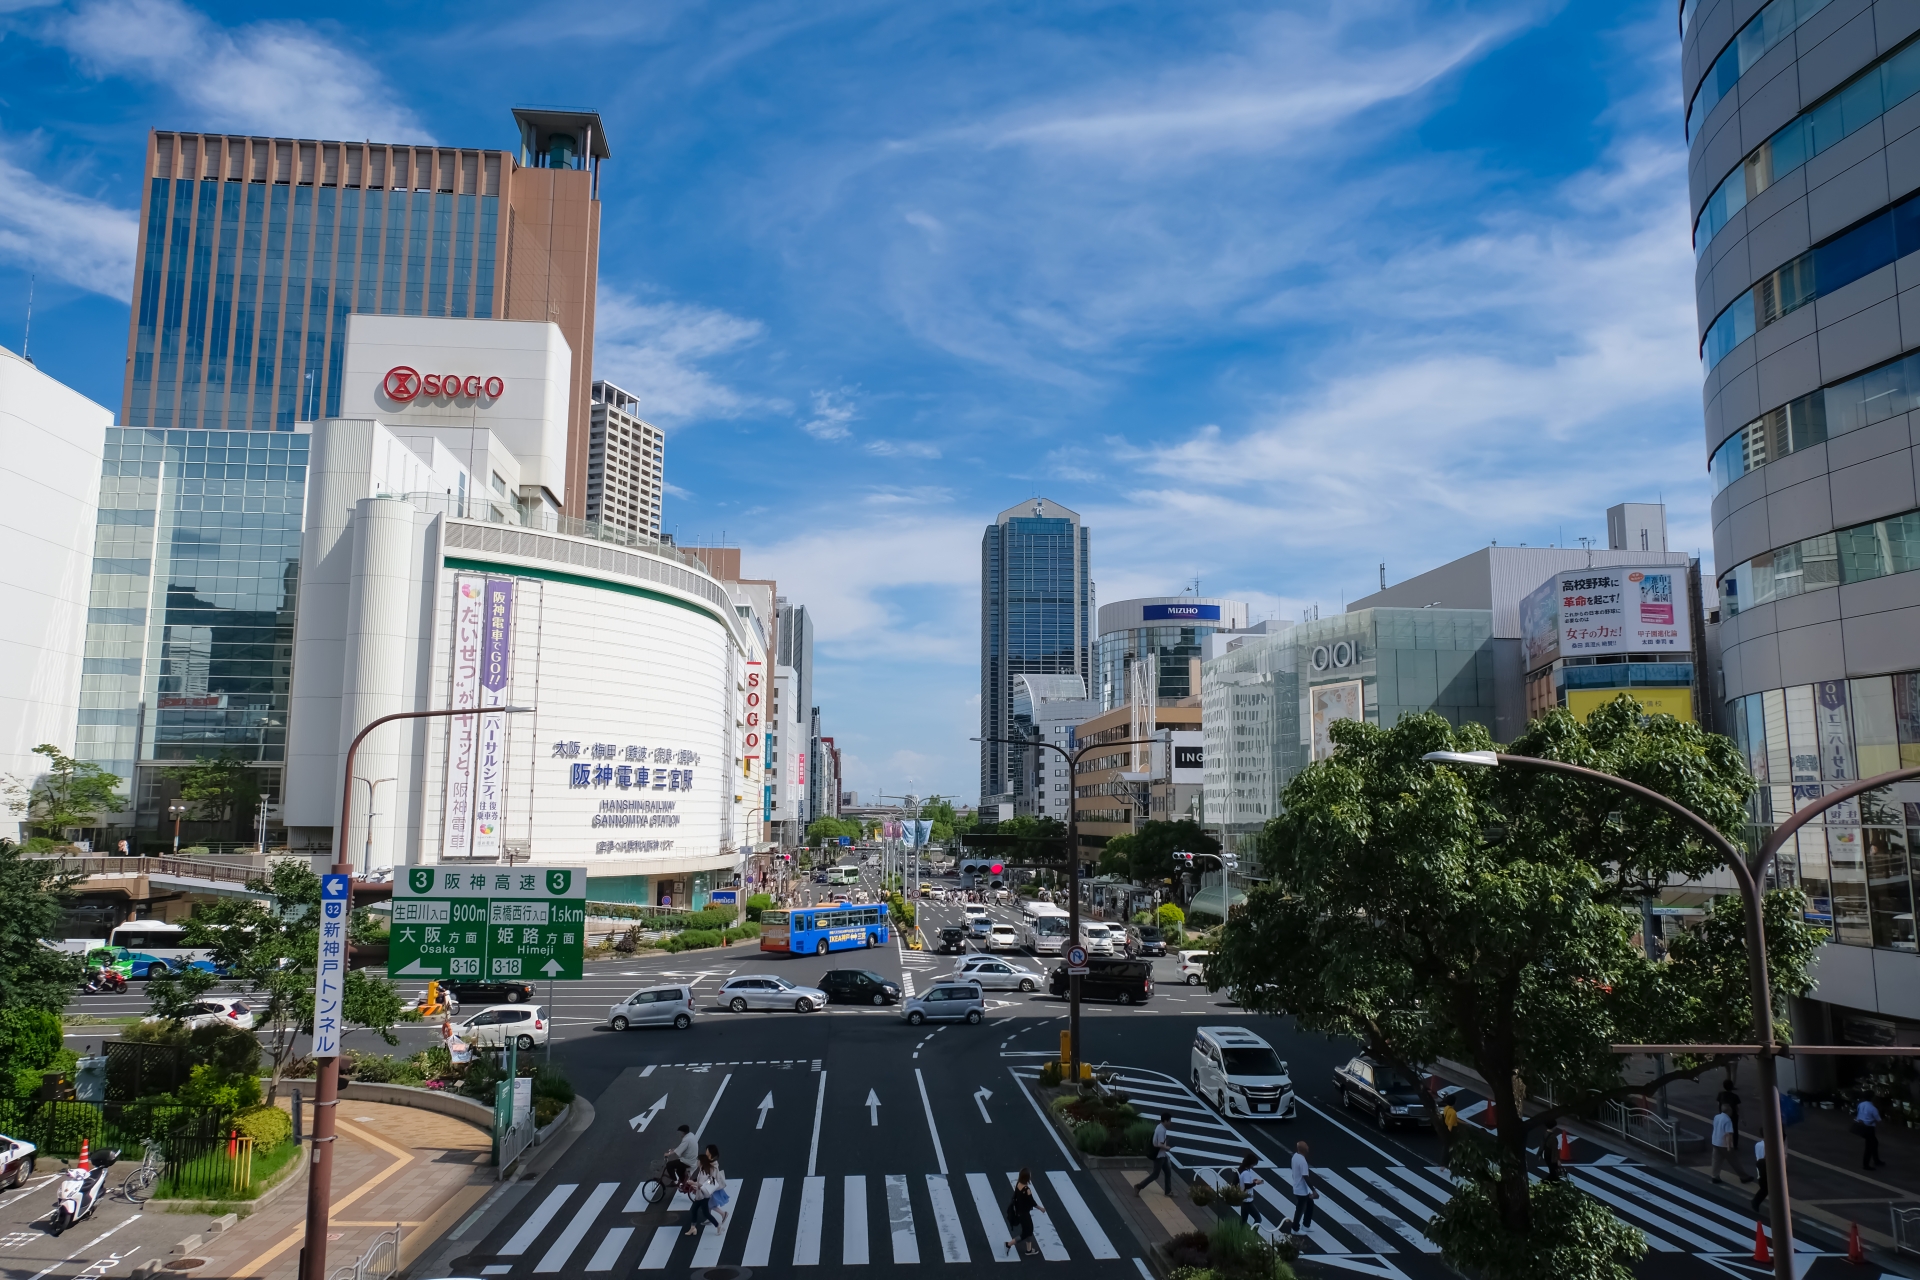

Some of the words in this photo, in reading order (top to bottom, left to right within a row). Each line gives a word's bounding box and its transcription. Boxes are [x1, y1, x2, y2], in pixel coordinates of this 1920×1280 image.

[423, 374, 505, 399] SOGO
[1561, 576, 1620, 592] 高校野球に
[746, 673, 760, 747] SOGO
[571, 763, 693, 789] 阪神電車三宮駅
[602, 800, 643, 811] HANSHIN
[645, 801, 676, 811] RAILWAY
[450, 782, 468, 849] 阪神電車
[595, 815, 649, 825] SANNOMIYA
[652, 815, 680, 825] STATION
[415, 872, 428, 888] 3
[444, 873, 536, 891] 阪神高速
[552, 873, 565, 889] 3
[327, 905, 340, 914] 32
[394, 904, 448, 921] 生田川入口
[453, 904, 486, 922] 900m
[492, 904, 547, 922] 京橋西行入口
[551, 905, 584, 923] 1.5km
[420, 944, 456, 954] Osaka
[517, 945, 554, 956] Himeji
[451, 959, 478, 974] 3-16
[494, 959, 520, 974] 3-18
[316, 921, 341, 1052] 新神戸トンネル
